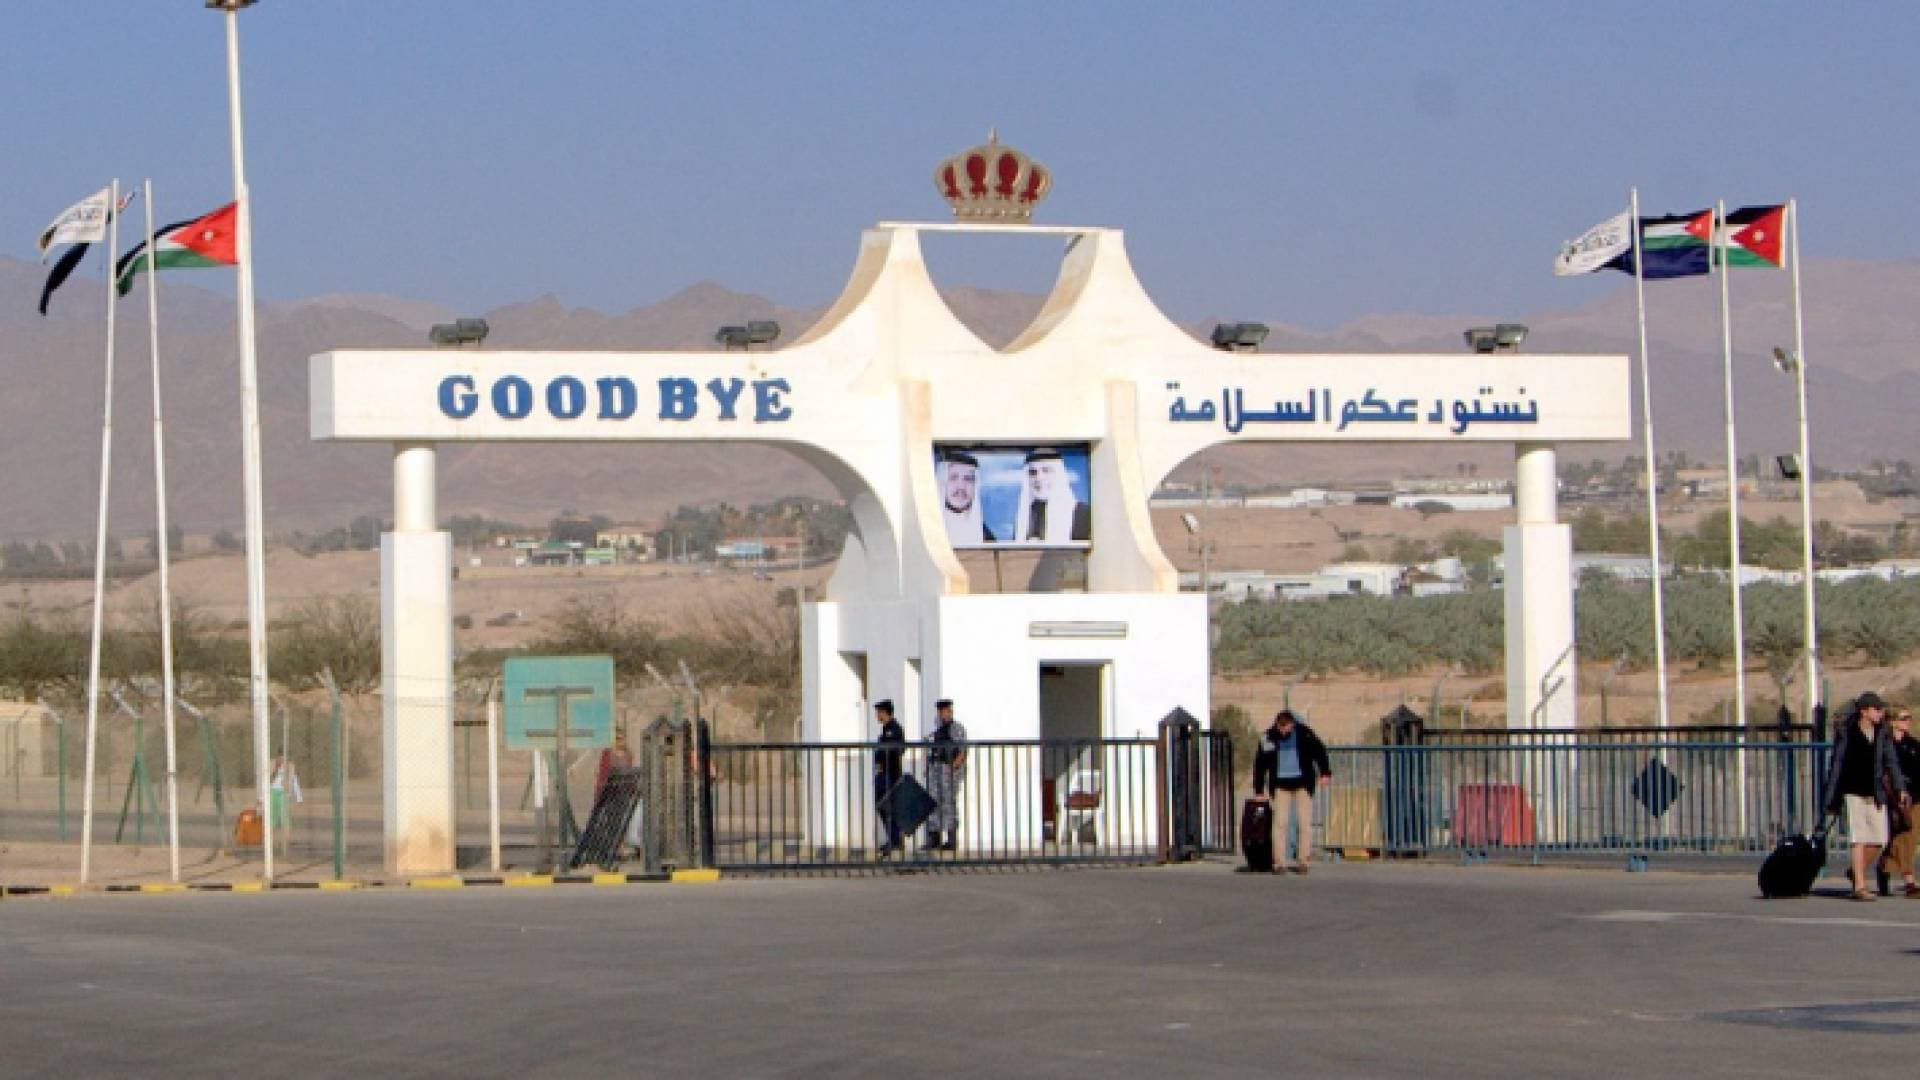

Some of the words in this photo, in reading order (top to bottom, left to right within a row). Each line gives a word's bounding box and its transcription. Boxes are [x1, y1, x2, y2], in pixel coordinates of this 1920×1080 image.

[438, 375, 637, 420] GOOD
[659, 378, 792, 422] BYE
[1167, 383, 1331, 433] السلامة
[1337, 387, 1538, 434] نستودعكم
